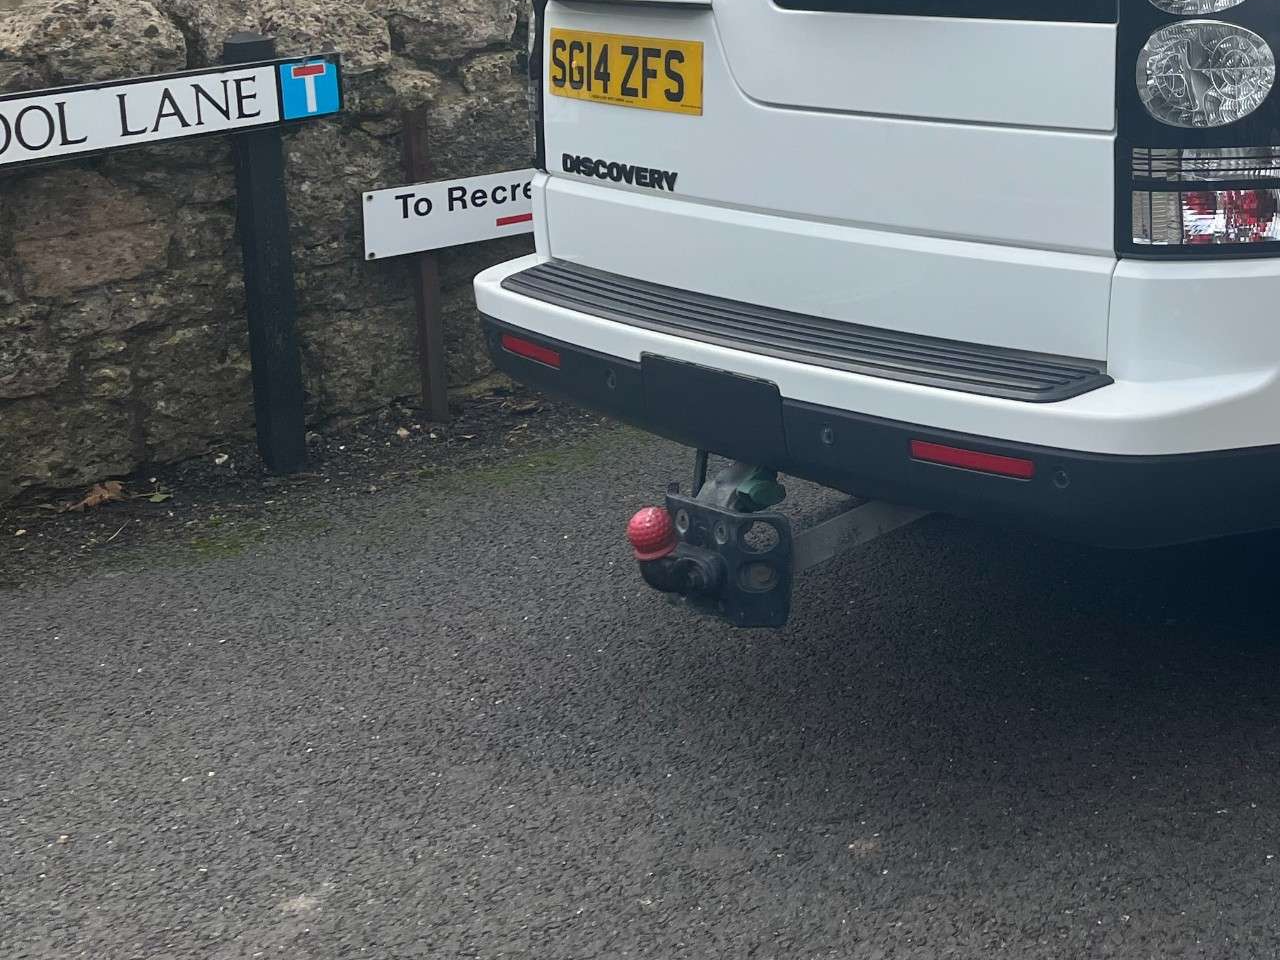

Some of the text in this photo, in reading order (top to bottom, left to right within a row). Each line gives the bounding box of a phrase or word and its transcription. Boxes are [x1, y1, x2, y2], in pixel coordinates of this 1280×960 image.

[552, 39, 685, 103] SG14 ZFS
[0, 75, 261, 156] OL LANE
[562, 153, 678, 192] DISCOVERY
[395, 192, 433, 219] To
